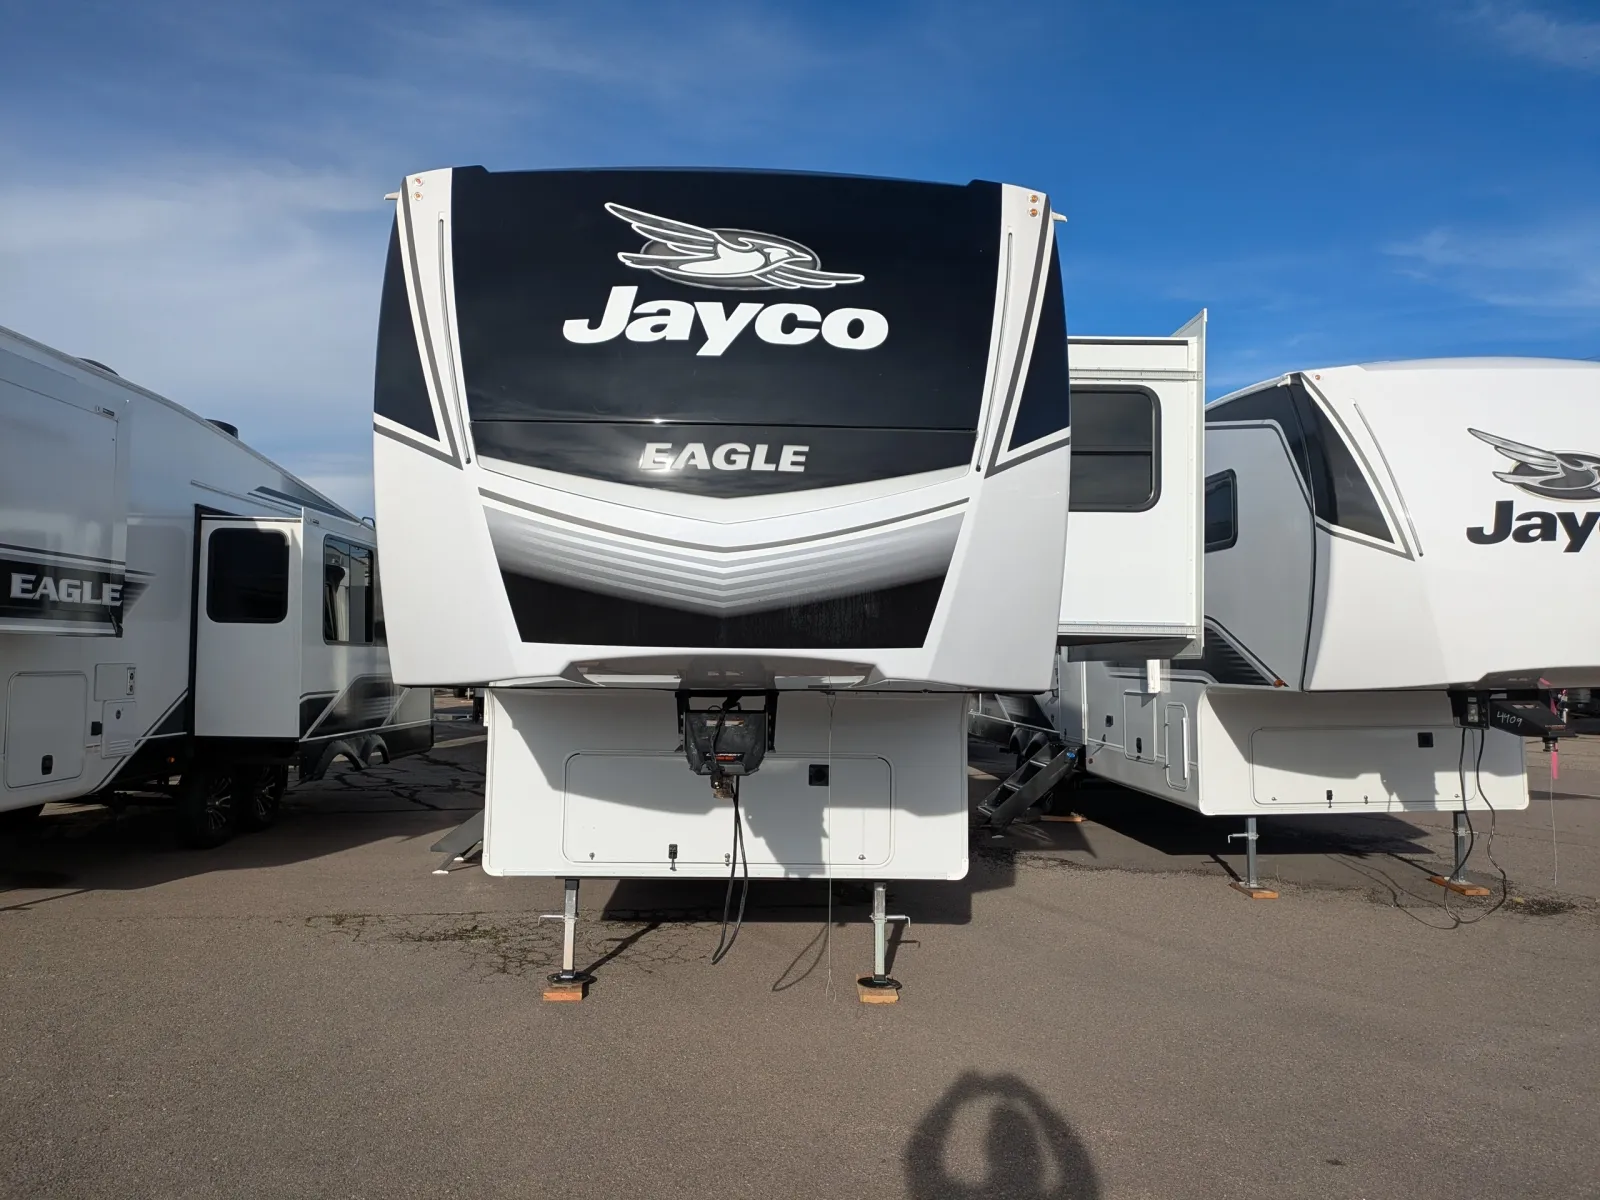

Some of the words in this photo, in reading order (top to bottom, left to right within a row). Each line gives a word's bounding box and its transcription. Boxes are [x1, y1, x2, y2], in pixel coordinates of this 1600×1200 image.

[562, 286, 889, 356] Jayco
[638, 442, 810, 472] EAGLE
[1466, 500, 1600, 553] Jay
[9, 572, 123, 606] EAGLE
